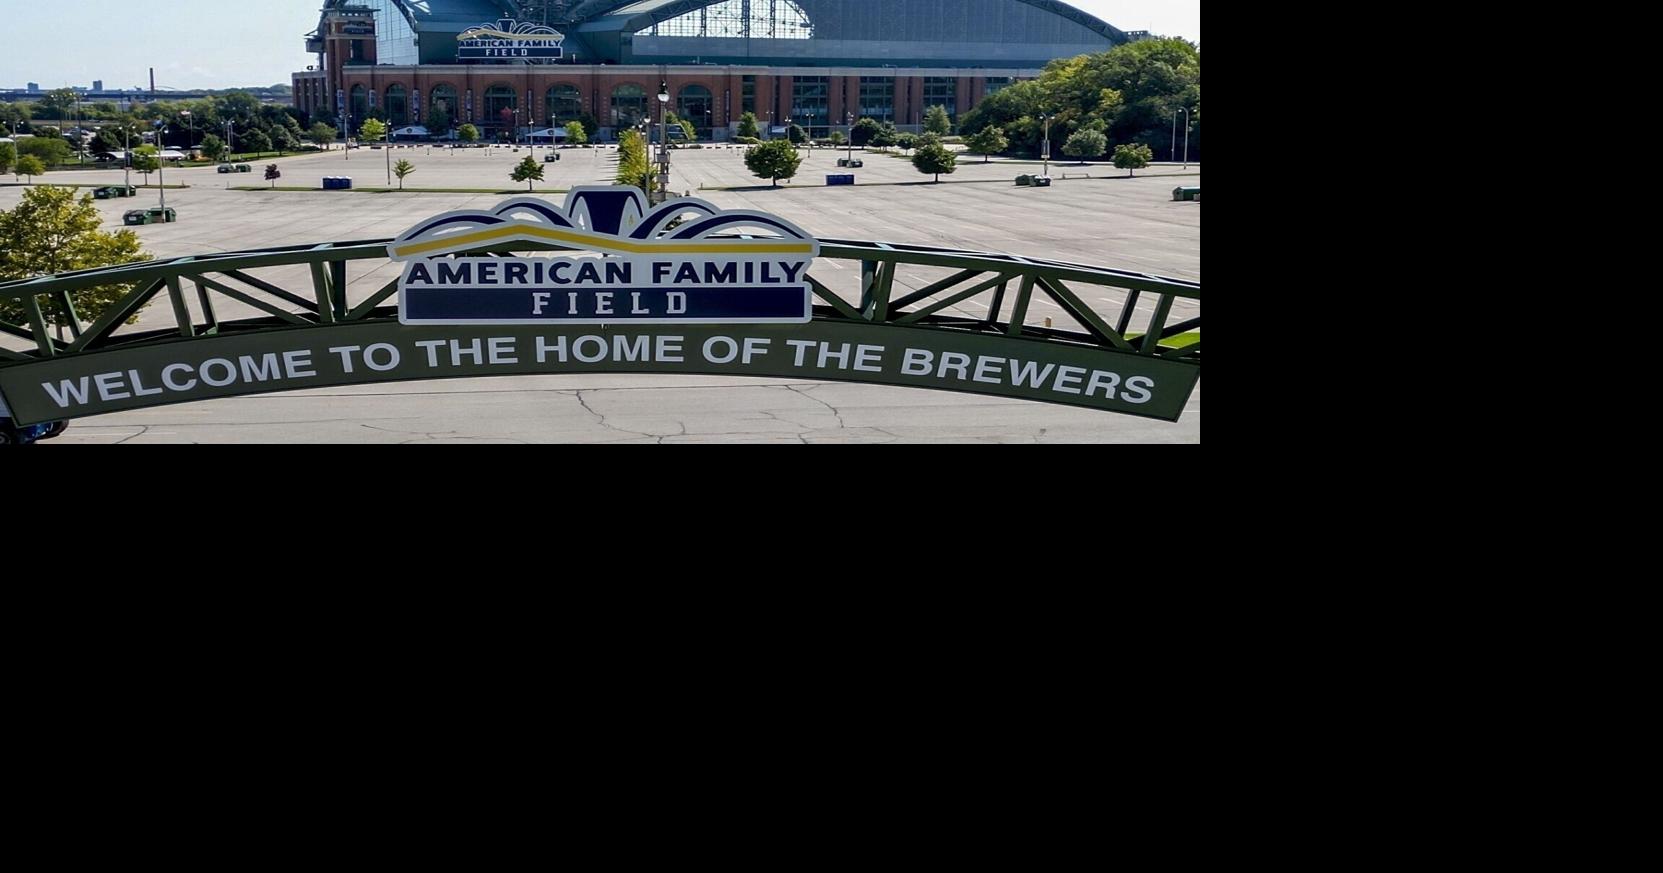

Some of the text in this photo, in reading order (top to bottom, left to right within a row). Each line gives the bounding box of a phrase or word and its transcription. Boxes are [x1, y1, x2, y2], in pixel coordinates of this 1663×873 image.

[406, 261, 806, 285] AMERICAN FAMILY
[532, 292, 686, 315] FIELD
[42, 334, 1155, 408] WELCOME TO THE HOME OF THE BREWERS
